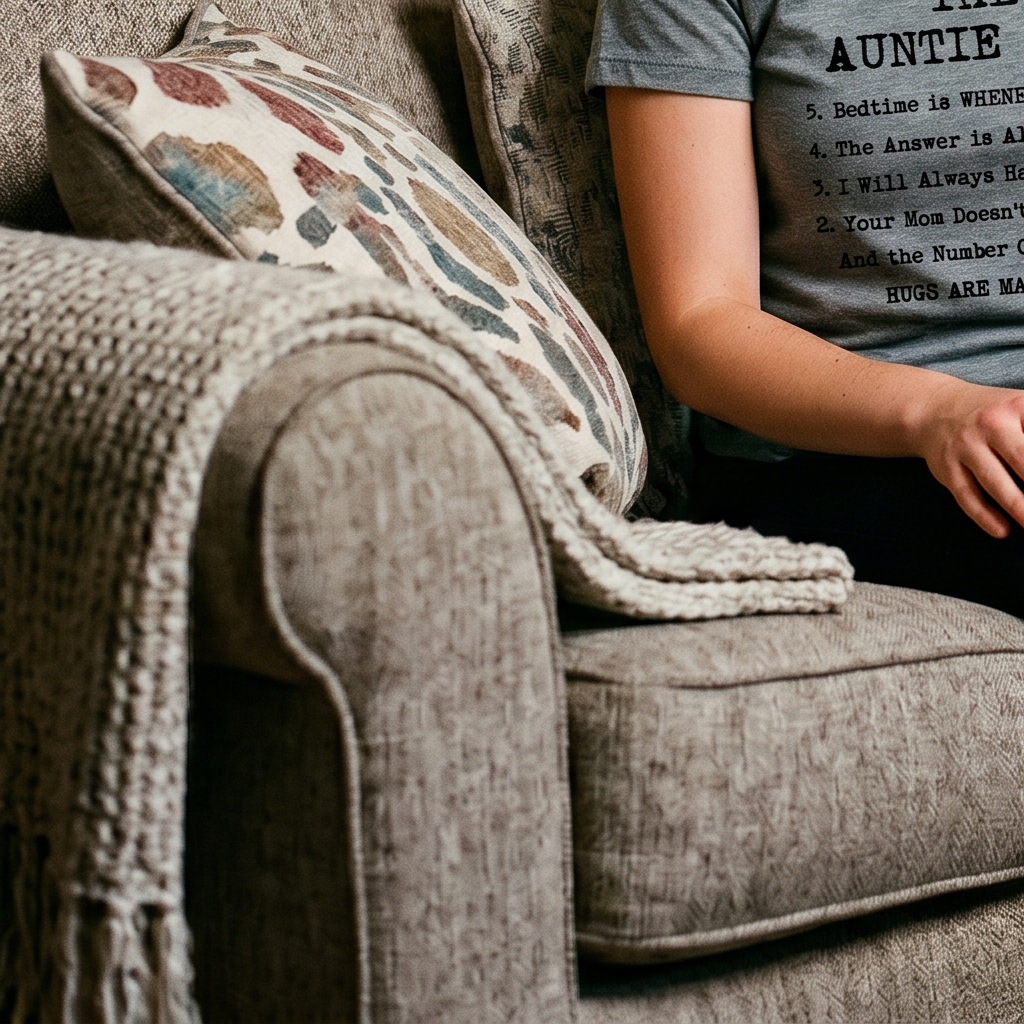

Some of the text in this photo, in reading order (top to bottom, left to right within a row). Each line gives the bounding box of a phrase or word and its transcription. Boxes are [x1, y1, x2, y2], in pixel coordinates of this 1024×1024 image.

[825, 23, 1001, 73] AUNTIE
[806, 103, 823, 121] 5.
[832, 97, 919, 119] Bedtime
[928, 93, 951, 112] is
[809, 142, 828, 159] 4.
[835, 140, 874, 158] The
[883, 136, 961, 154] Answer
[970, 129, 994, 147] is
[812, 179, 831, 197] 3.
[838, 178, 850, 196] I
[857, 173, 908, 194] Will
[917, 170, 995, 189] Always
[816, 216, 836, 233] 2.
[843, 215, 896, 233] Your
[904, 210, 946, 228] Mom
[838, 250, 880, 270] And
[887, 248, 924, 266] the
[932, 242, 1009, 263] Number
[885, 282, 939, 304] HUGS
[947, 279, 990, 299] ARE
